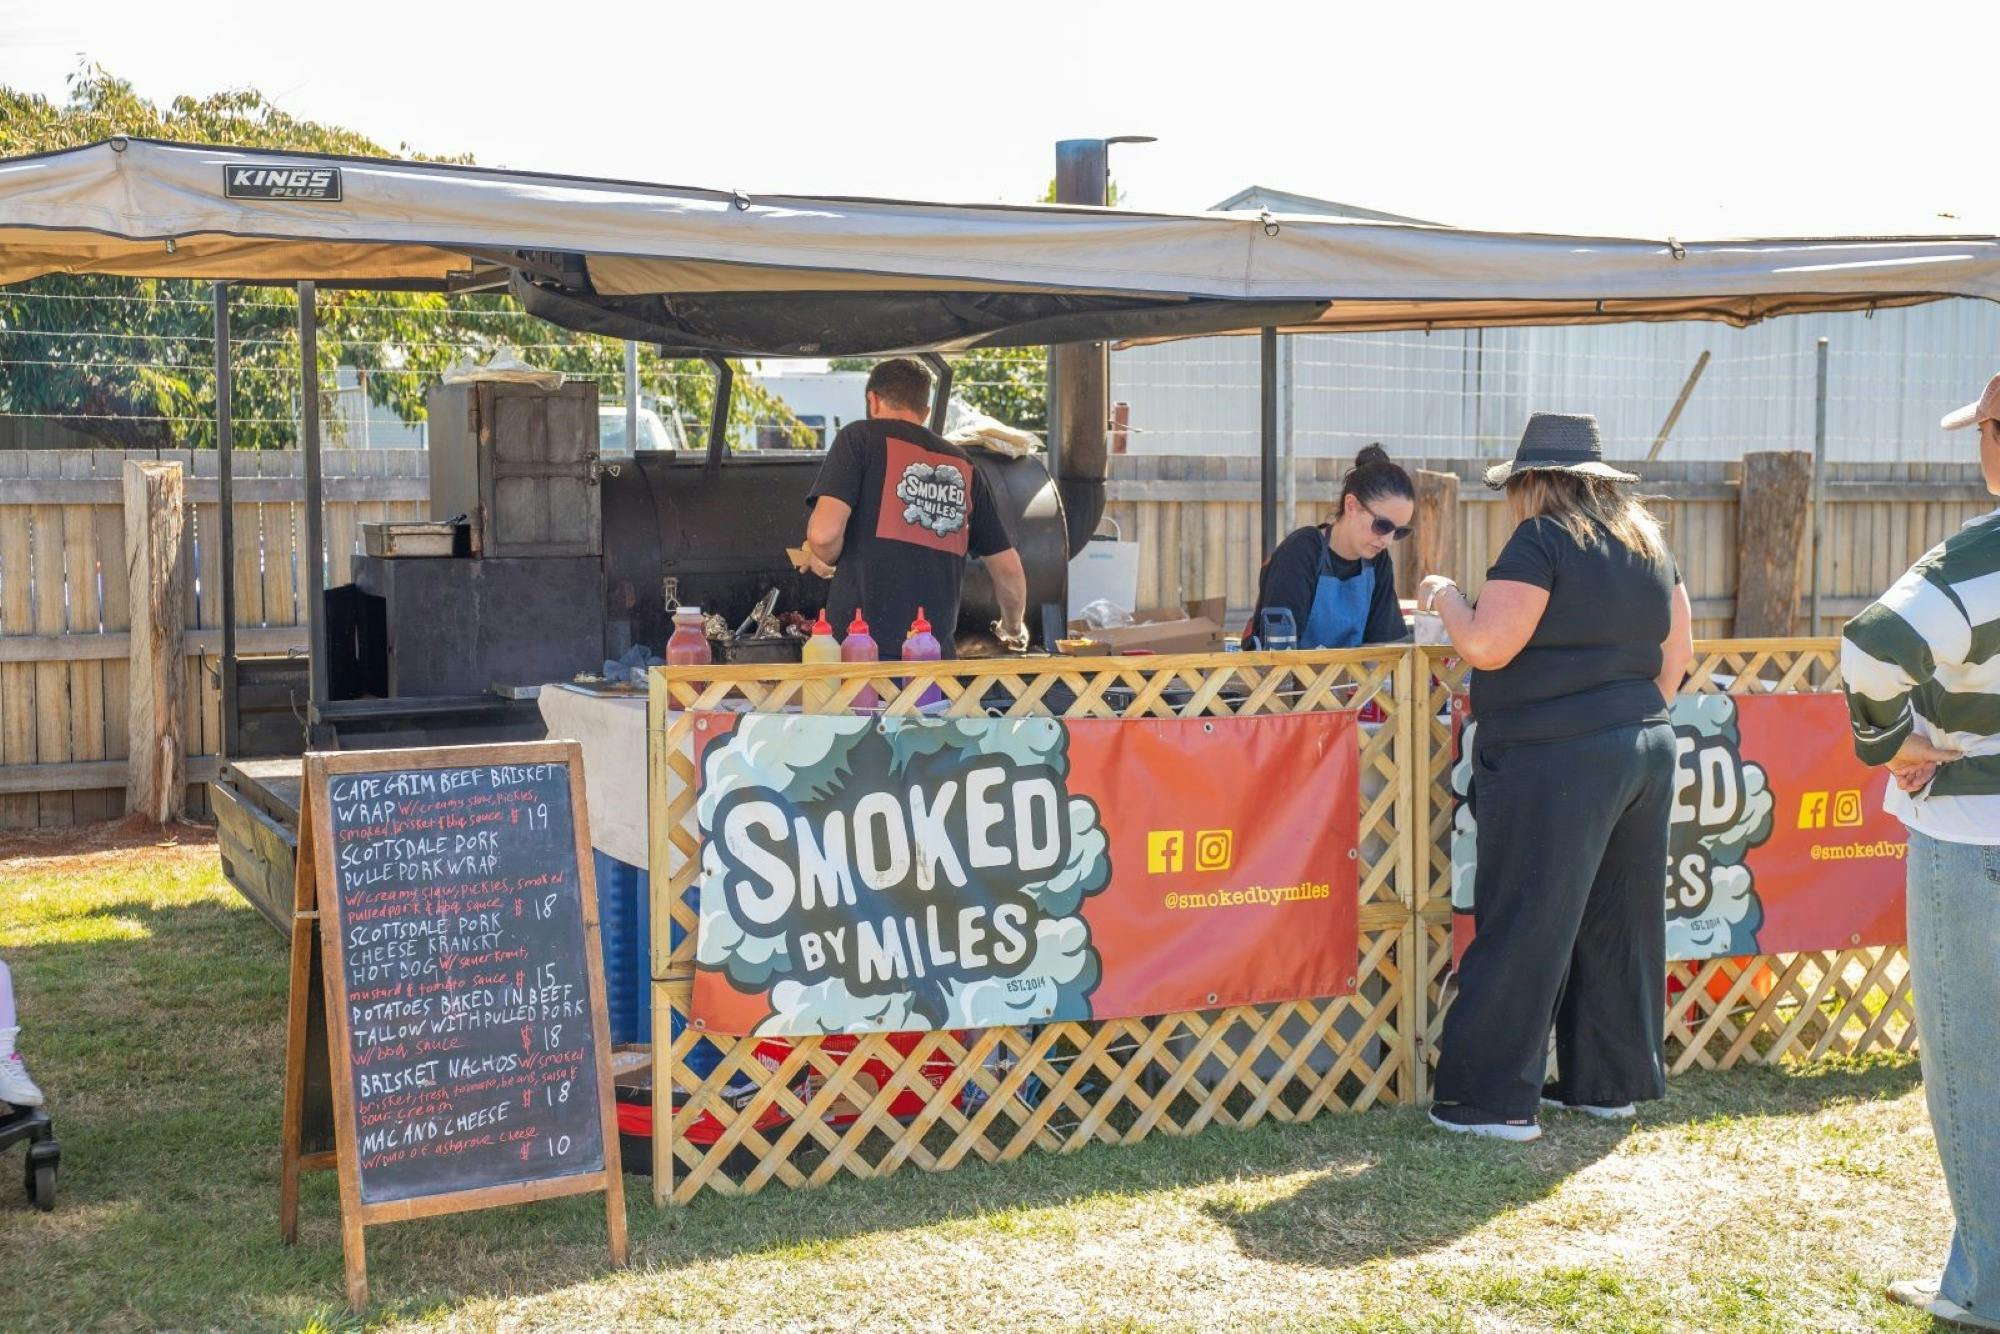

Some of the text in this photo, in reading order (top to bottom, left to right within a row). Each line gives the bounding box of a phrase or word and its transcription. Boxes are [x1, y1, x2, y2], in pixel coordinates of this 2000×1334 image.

[233, 169, 332, 187] KINGS
[270, 188, 325, 197] PLUS
[907, 475, 964, 506] SMOKED
[923, 501, 956, 517] MILES
[333, 765, 552, 801] CAPE GRIM BEEF BRISKET
[338, 801, 395, 824] WRAP
[528, 803, 547, 830] 19
[341, 831, 498, 869] SCOTTSDALE PORK
[724, 766, 1061, 925] SMOKED
[1811, 841, 1907, 860] @smokedby
[399, 859, 443, 880] PORK
[447, 854, 497, 875] WRAP
[535, 893, 556, 920] 18
[1165, 882, 1330, 909] @smokedbymiles
[348, 912, 500, 949] SCOTTSDALE PORK
[800, 904, 1027, 983] BY MILES
[349, 930, 503, 966] CHEESE KRANSKY
[353, 963, 394, 985] HOT
[400, 958, 437, 982] DOG
[537, 962, 555, 990] 15
[353, 984, 572, 1025] POTATOES BAKED IN BEEF
[354, 1000, 584, 1047] TALLOW WITH PULLED PORK
[545, 1024, 562, 1050] 18
[361, 1061, 439, 1097] BRISKET
[449, 1054, 518, 1078] NACHOS
[547, 1081, 570, 1106] 18
[363, 1101, 511, 1155] MAC AND CHEESE
[549, 1135, 570, 1157] 10
